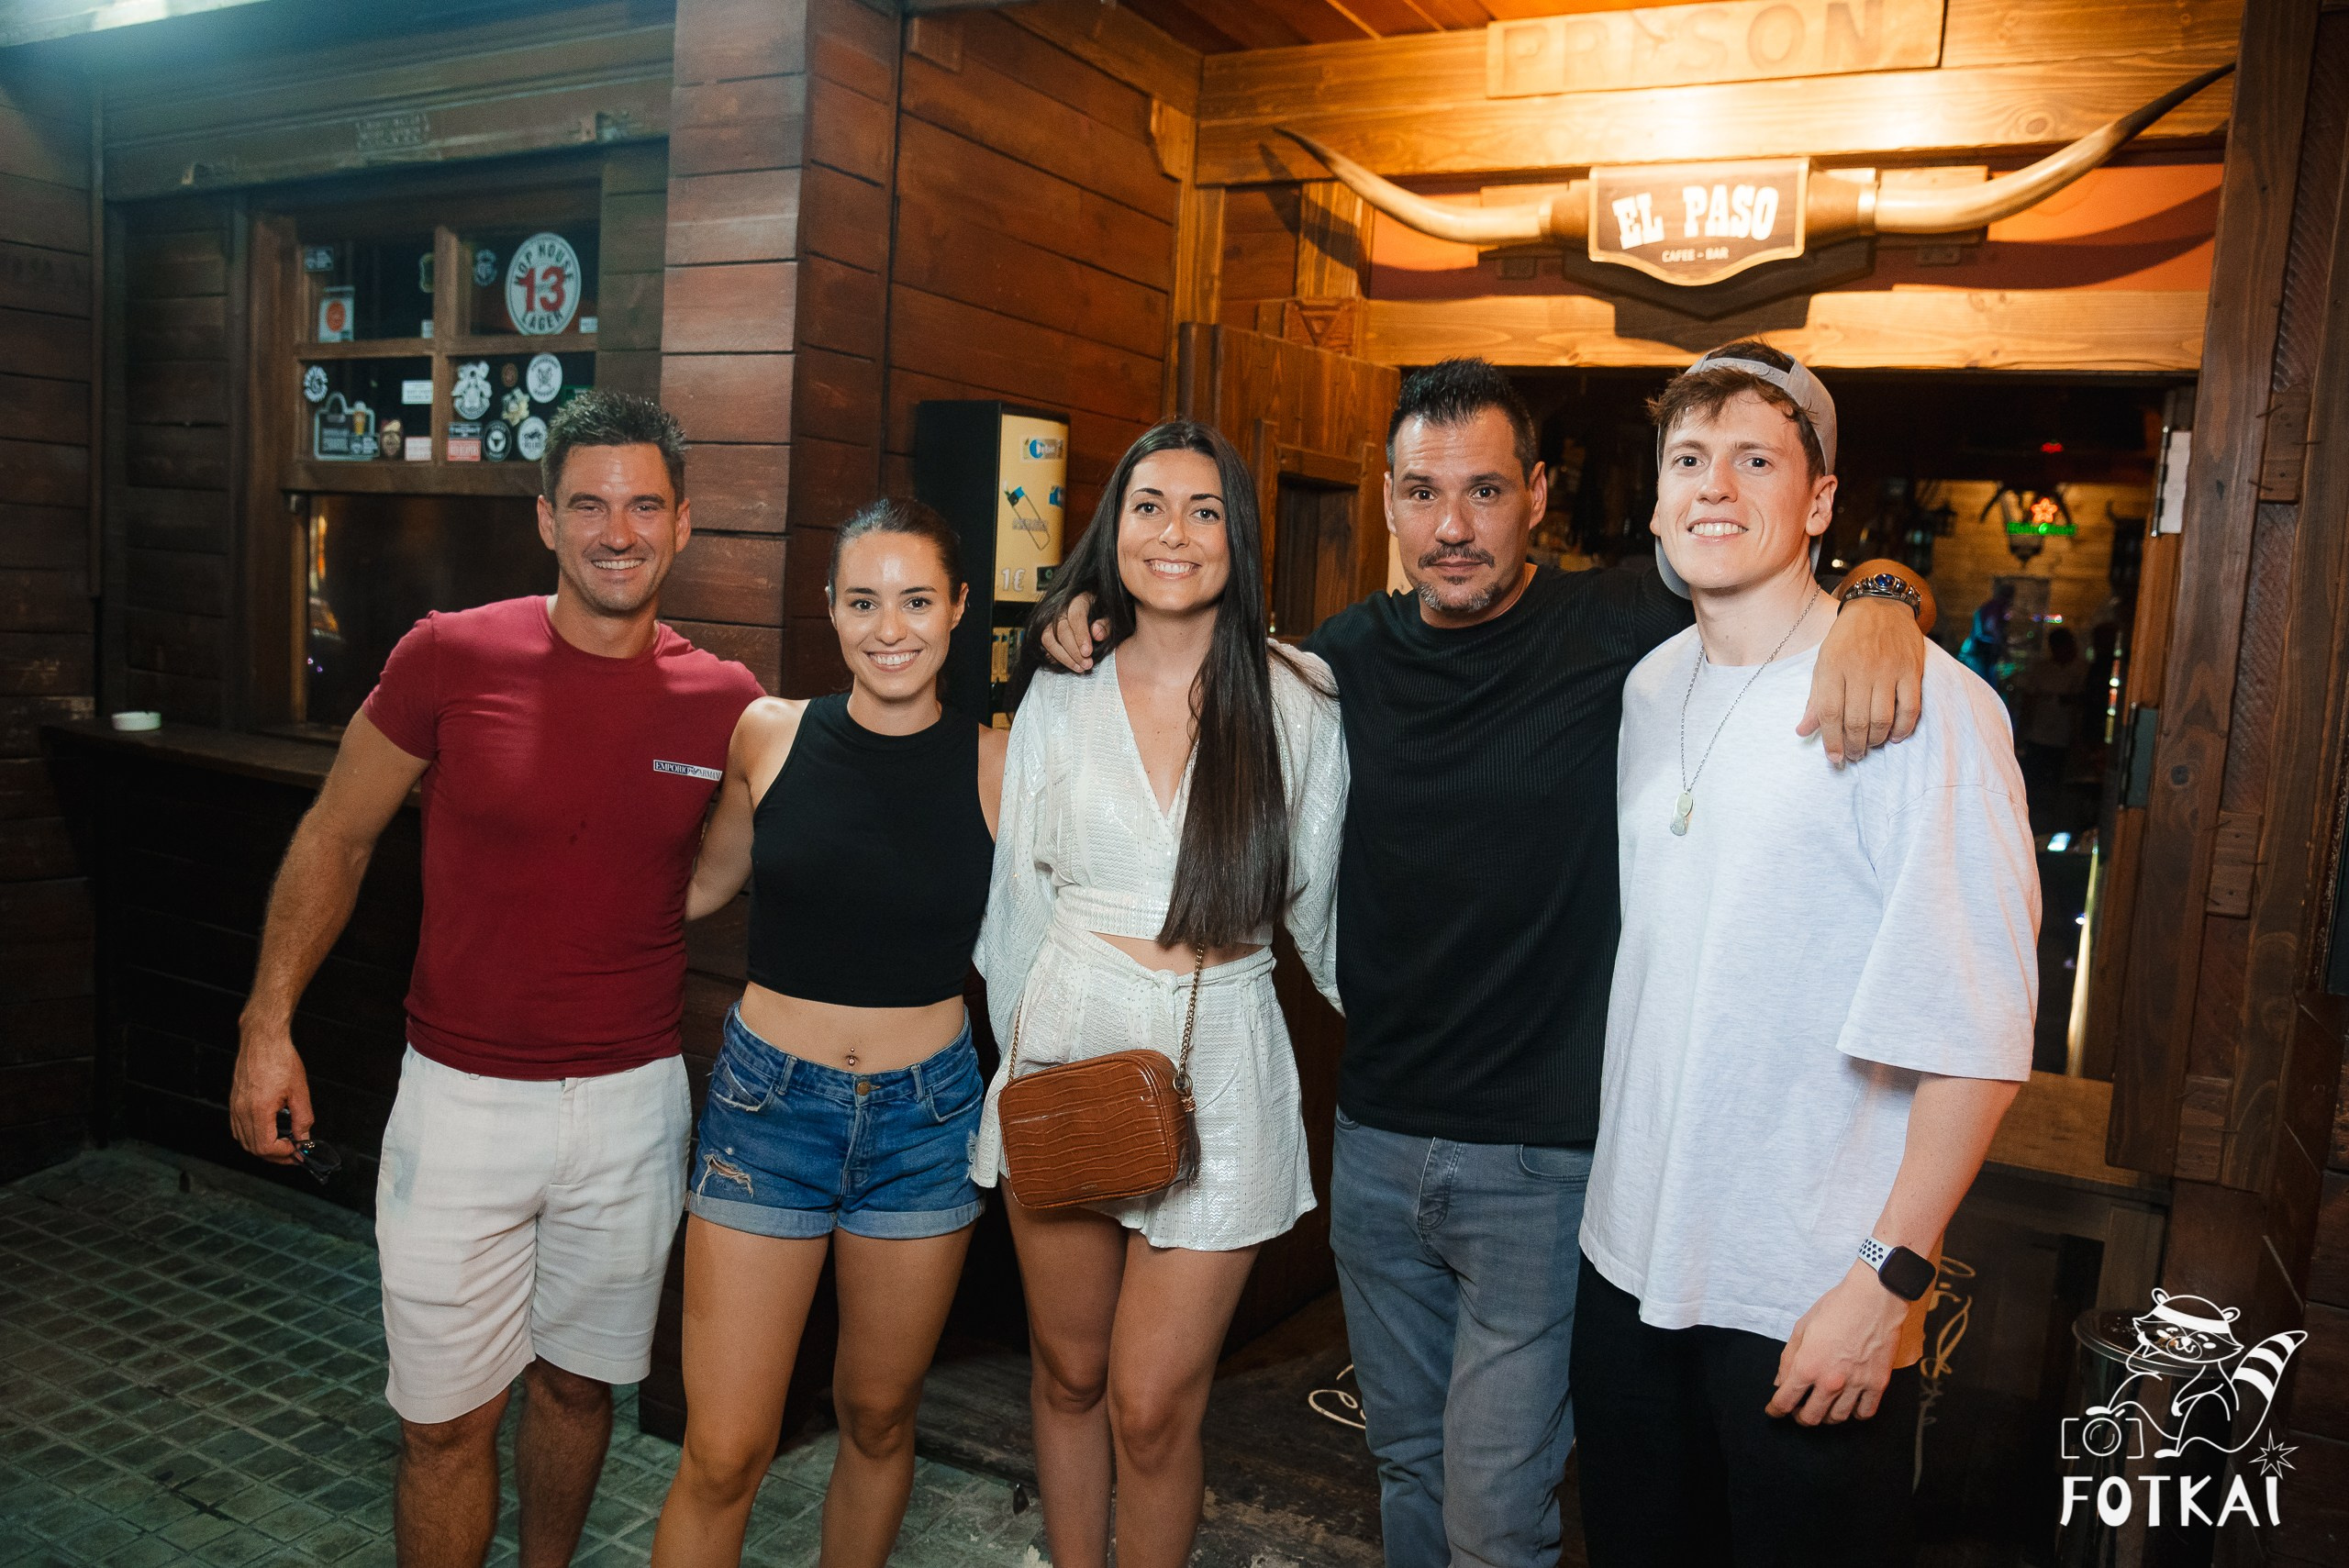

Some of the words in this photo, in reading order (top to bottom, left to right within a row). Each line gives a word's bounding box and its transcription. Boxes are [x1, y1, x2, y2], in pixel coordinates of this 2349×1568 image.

[1612, 192, 1665, 250] EL
[1682, 183, 1779, 240] PASO
[538, 243, 575, 280] HOUSE
[1705, 246, 1730, 261] BAR
[518, 265, 566, 313] 13
[521, 309, 563, 331] LAGER
[1001, 566, 1026, 593] 1€
[654, 761, 692, 775] EMPORIO
